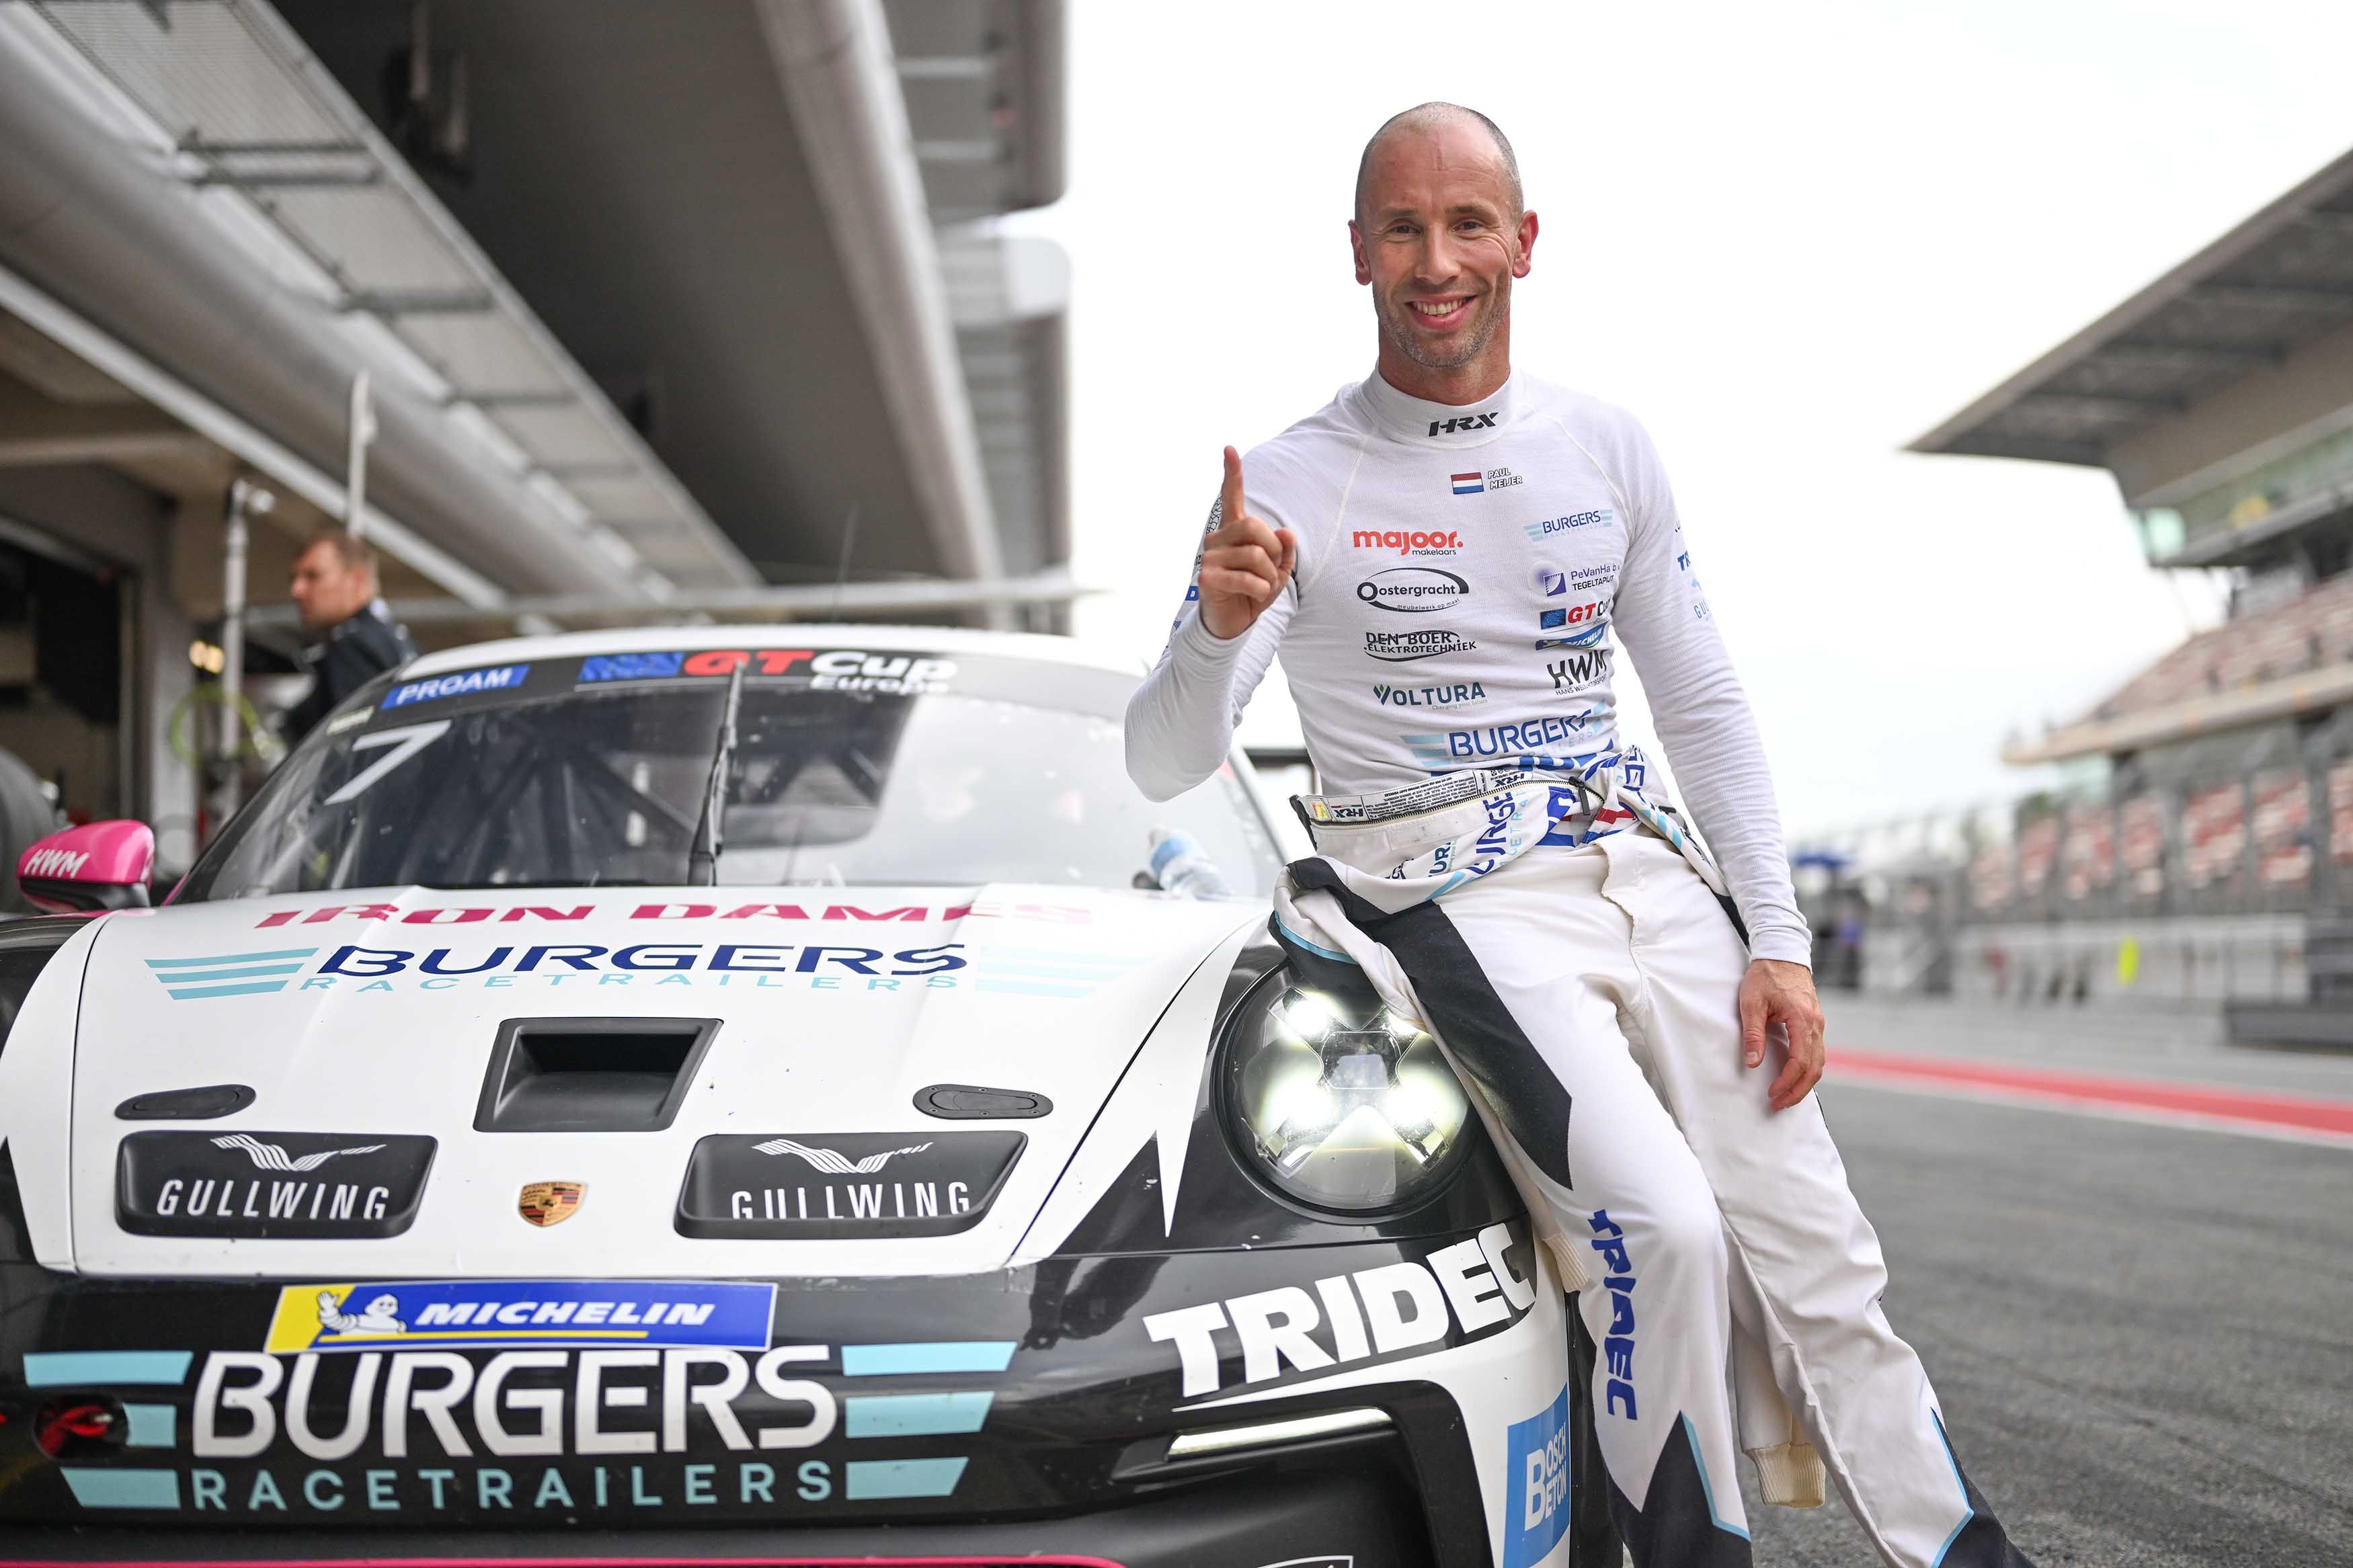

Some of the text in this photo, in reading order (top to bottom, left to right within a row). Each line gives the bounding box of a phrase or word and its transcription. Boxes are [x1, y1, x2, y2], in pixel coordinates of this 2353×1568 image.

[1429, 412, 1499, 437] HRX
[1488, 467, 1511, 479] PAUL
[1490, 476, 1523, 490] MEIJER
[1542, 510, 1601, 534] BURGERS
[1412, 548, 1457, 556] makelaars
[1571, 565, 1610, 580] PeVanHa
[1572, 575, 1614, 591] TEGELTAPIJT
[1357, 581, 1455, 602] Oostergracht
[1366, 631, 1452, 645] DEN BOER
[684, 650, 958, 681] GT Cup
[1547, 649, 1608, 688] HWM
[395, 669, 510, 707] PROAM
[809, 673, 949, 695] Europe
[1373, 682, 1486, 706] VOLTURA
[1556, 688, 1574, 696] HANS
[325, 718, 452, 807] 7
[1494, 774, 1525, 788] HRX
[1334, 808, 1363, 818] HRX
[24, 849, 90, 877] HWM
[254, 904, 596, 928] IRON
[317, 944, 968, 977] BURGERS
[300, 974, 959, 992] RACETRAILERS
[156, 1179, 390, 1221] GULLWING
[732, 1181, 969, 1220] GULLWING
[415, 1303, 715, 1325] MICHELIN
[1143, 1223, 1536, 1398] TRIDEC
[193, 1344, 837, 1460] BURGERS
[192, 1460, 832, 1511] RACETRAILERS
